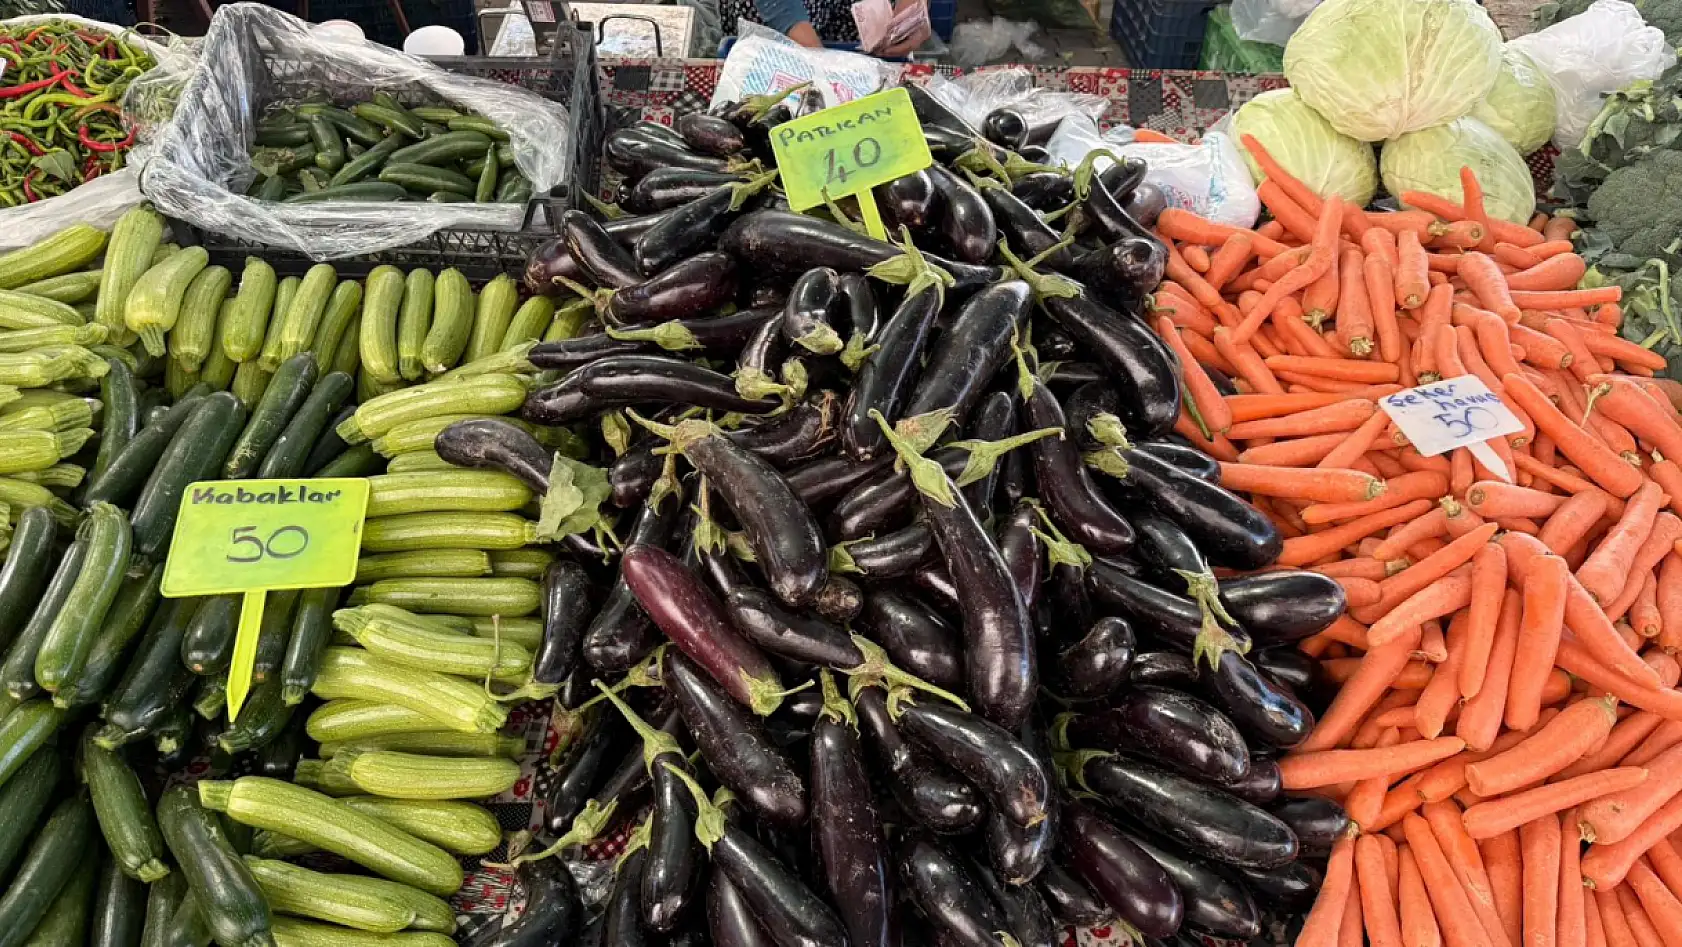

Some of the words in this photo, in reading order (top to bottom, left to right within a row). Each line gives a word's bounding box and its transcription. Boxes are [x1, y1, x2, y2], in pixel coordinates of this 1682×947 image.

[823, 137, 881, 185] 40
[1433, 406, 1499, 438] 50
[192, 485, 341, 505] Kabaklar
[226, 525, 309, 563] 50
